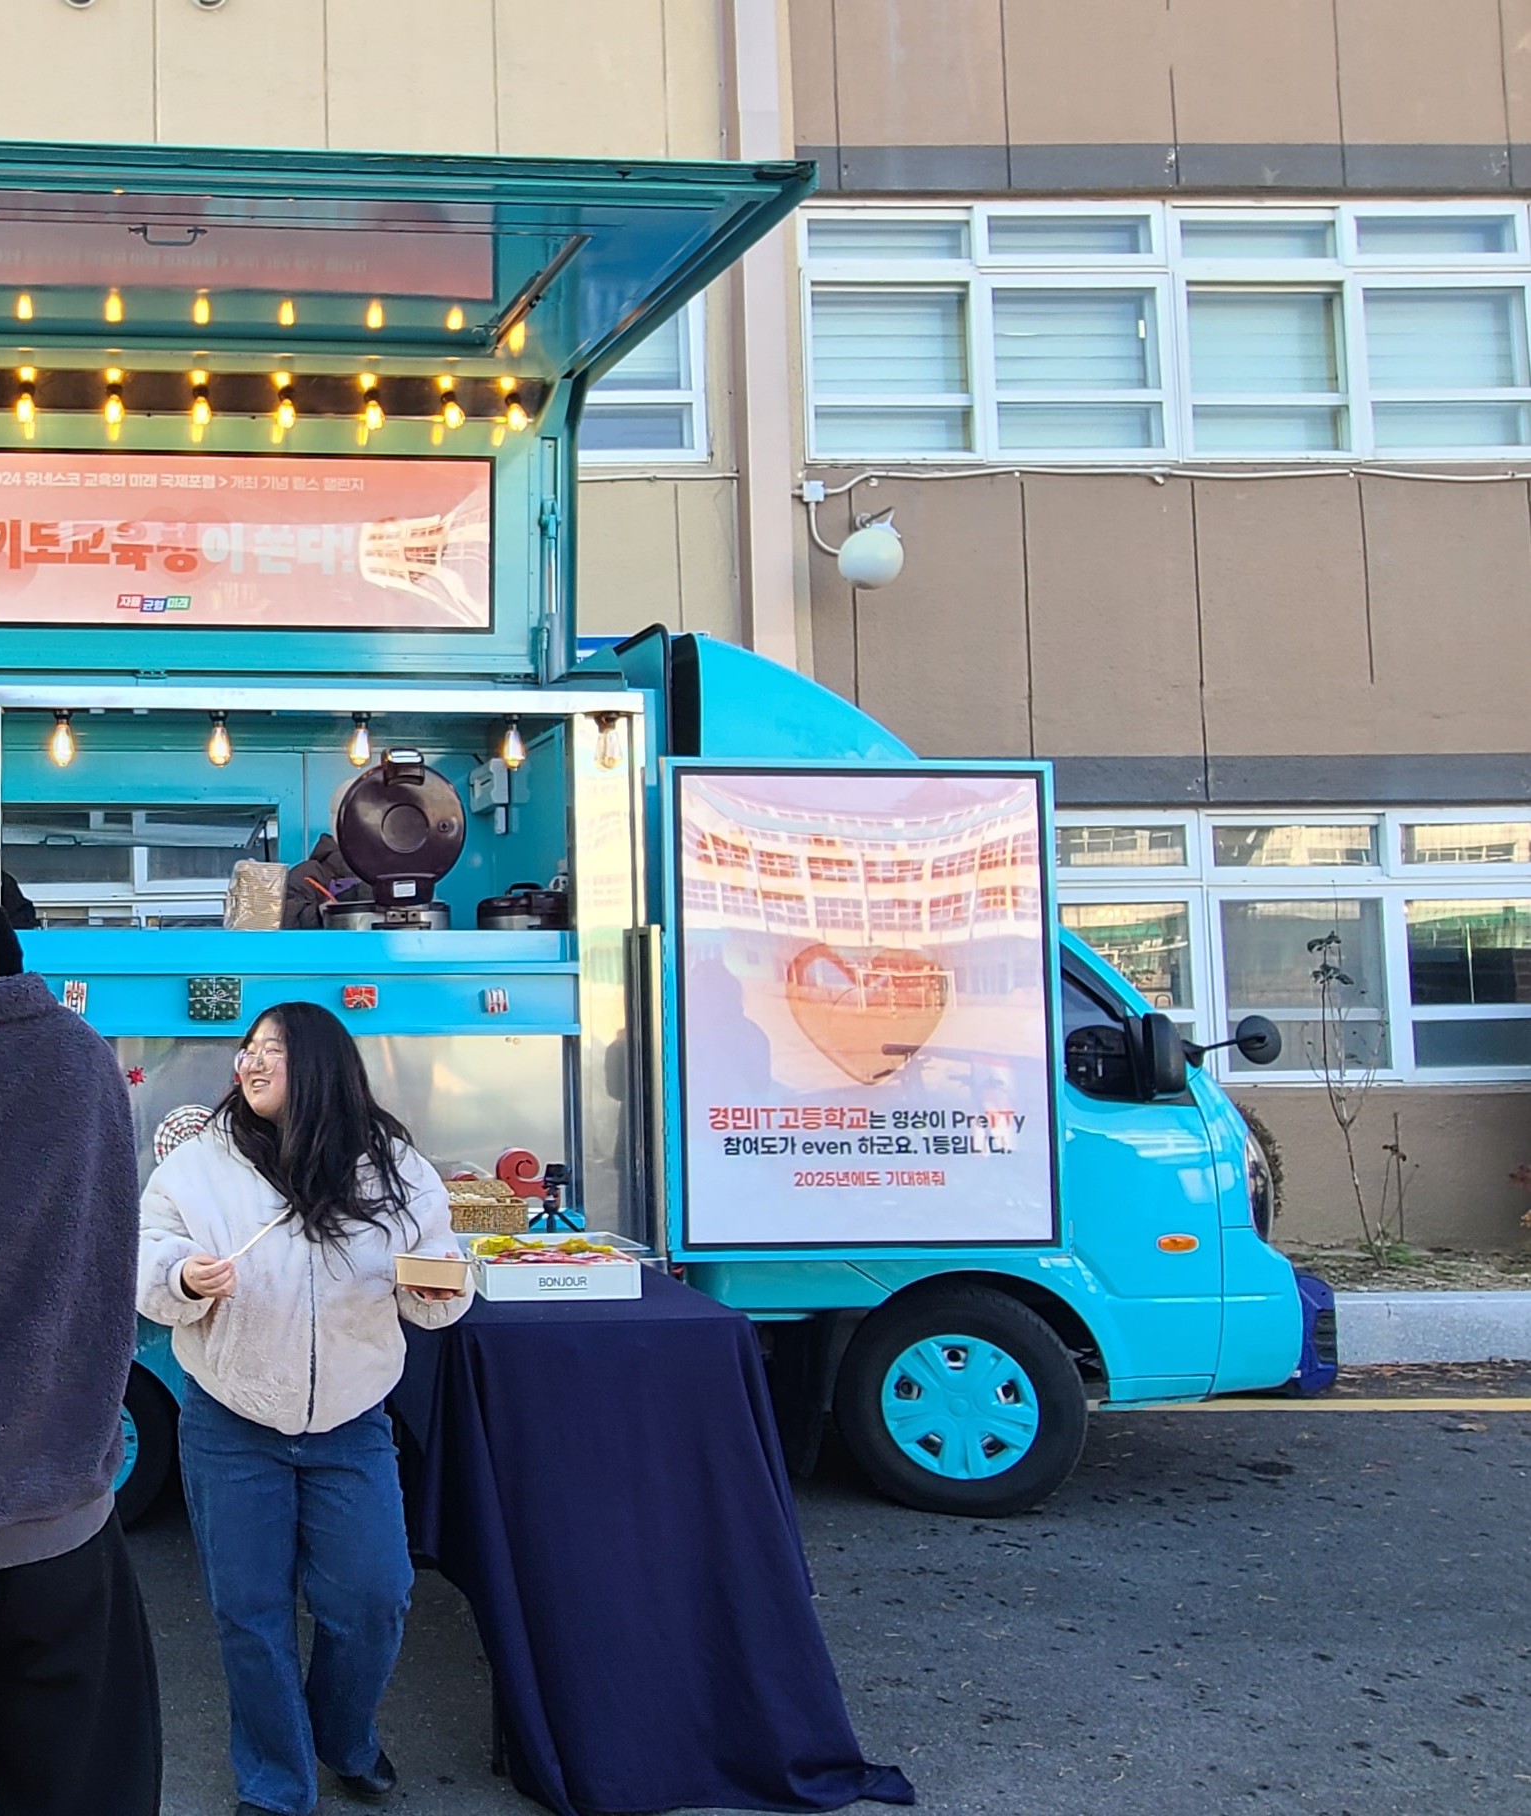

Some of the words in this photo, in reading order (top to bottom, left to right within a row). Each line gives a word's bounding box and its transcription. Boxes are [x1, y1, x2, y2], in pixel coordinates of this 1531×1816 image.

[25, 471, 80, 487] 유네스코
[84, 472, 126, 488] 교육의
[129, 473, 158, 488] 미래
[160, 473, 216, 489] 국제포럼
[231, 475, 258, 490] 개최
[262, 475, 289, 490] 기념
[323, 476, 364, 492] 챌린지
[708, 1106, 887, 1131] 경민IT고등학교는
[892, 1109, 946, 1130] 영상이
[723, 1136, 797, 1157] 참여도가
[801, 1139, 852, 1156] even
[857, 1137, 918, 1157] 하군요.
[793, 1171, 882, 1188] 2025년에도
[885, 1171, 945, 1188] 기대해줘
[538, 1276, 588, 1288] BONJOUR
